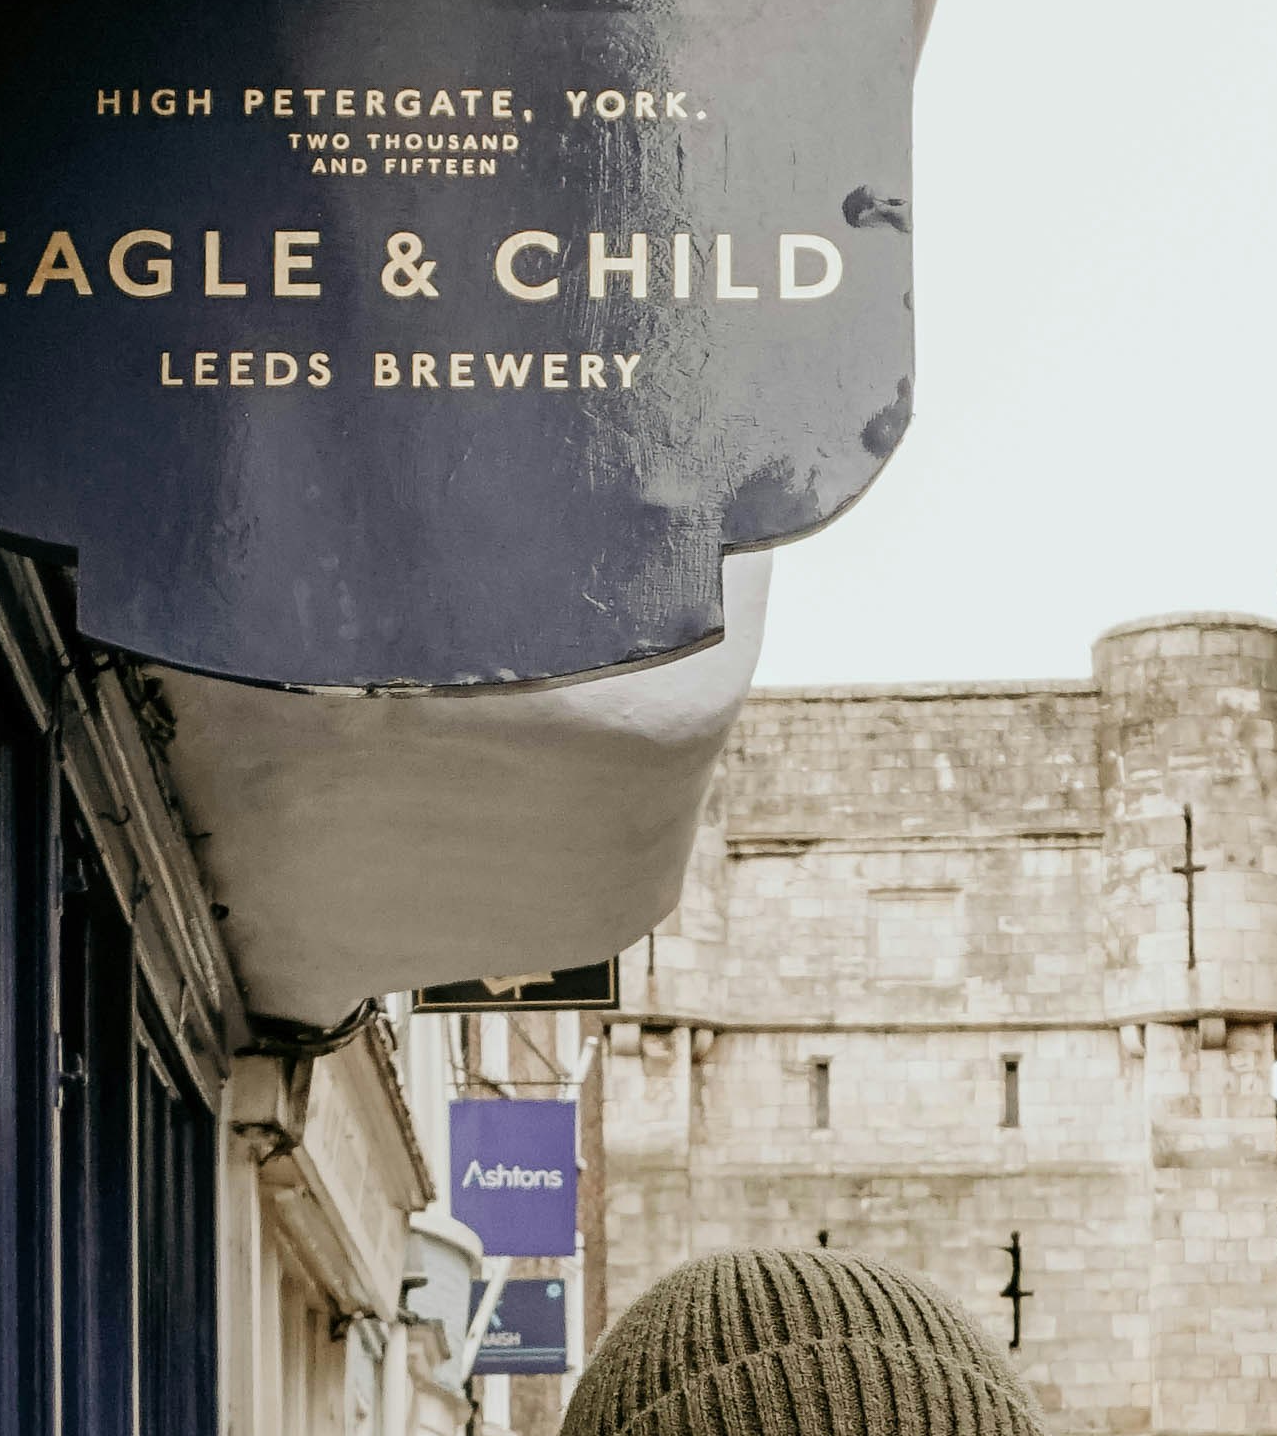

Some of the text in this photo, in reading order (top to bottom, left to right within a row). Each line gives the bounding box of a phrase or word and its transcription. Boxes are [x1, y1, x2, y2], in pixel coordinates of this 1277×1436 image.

[97, 89, 707, 122] HIGH PETERGATE, YORK.
[289, 133, 519, 151] TWO THOUSAND
[311, 158, 497, 175] AND FIFTEEN
[380, 231, 441, 298] &
[495, 231, 844, 300] CHILD
[160, 352, 641, 388] LEEDS BREWERY
[463, 1161, 563, 1189] Ashtons
